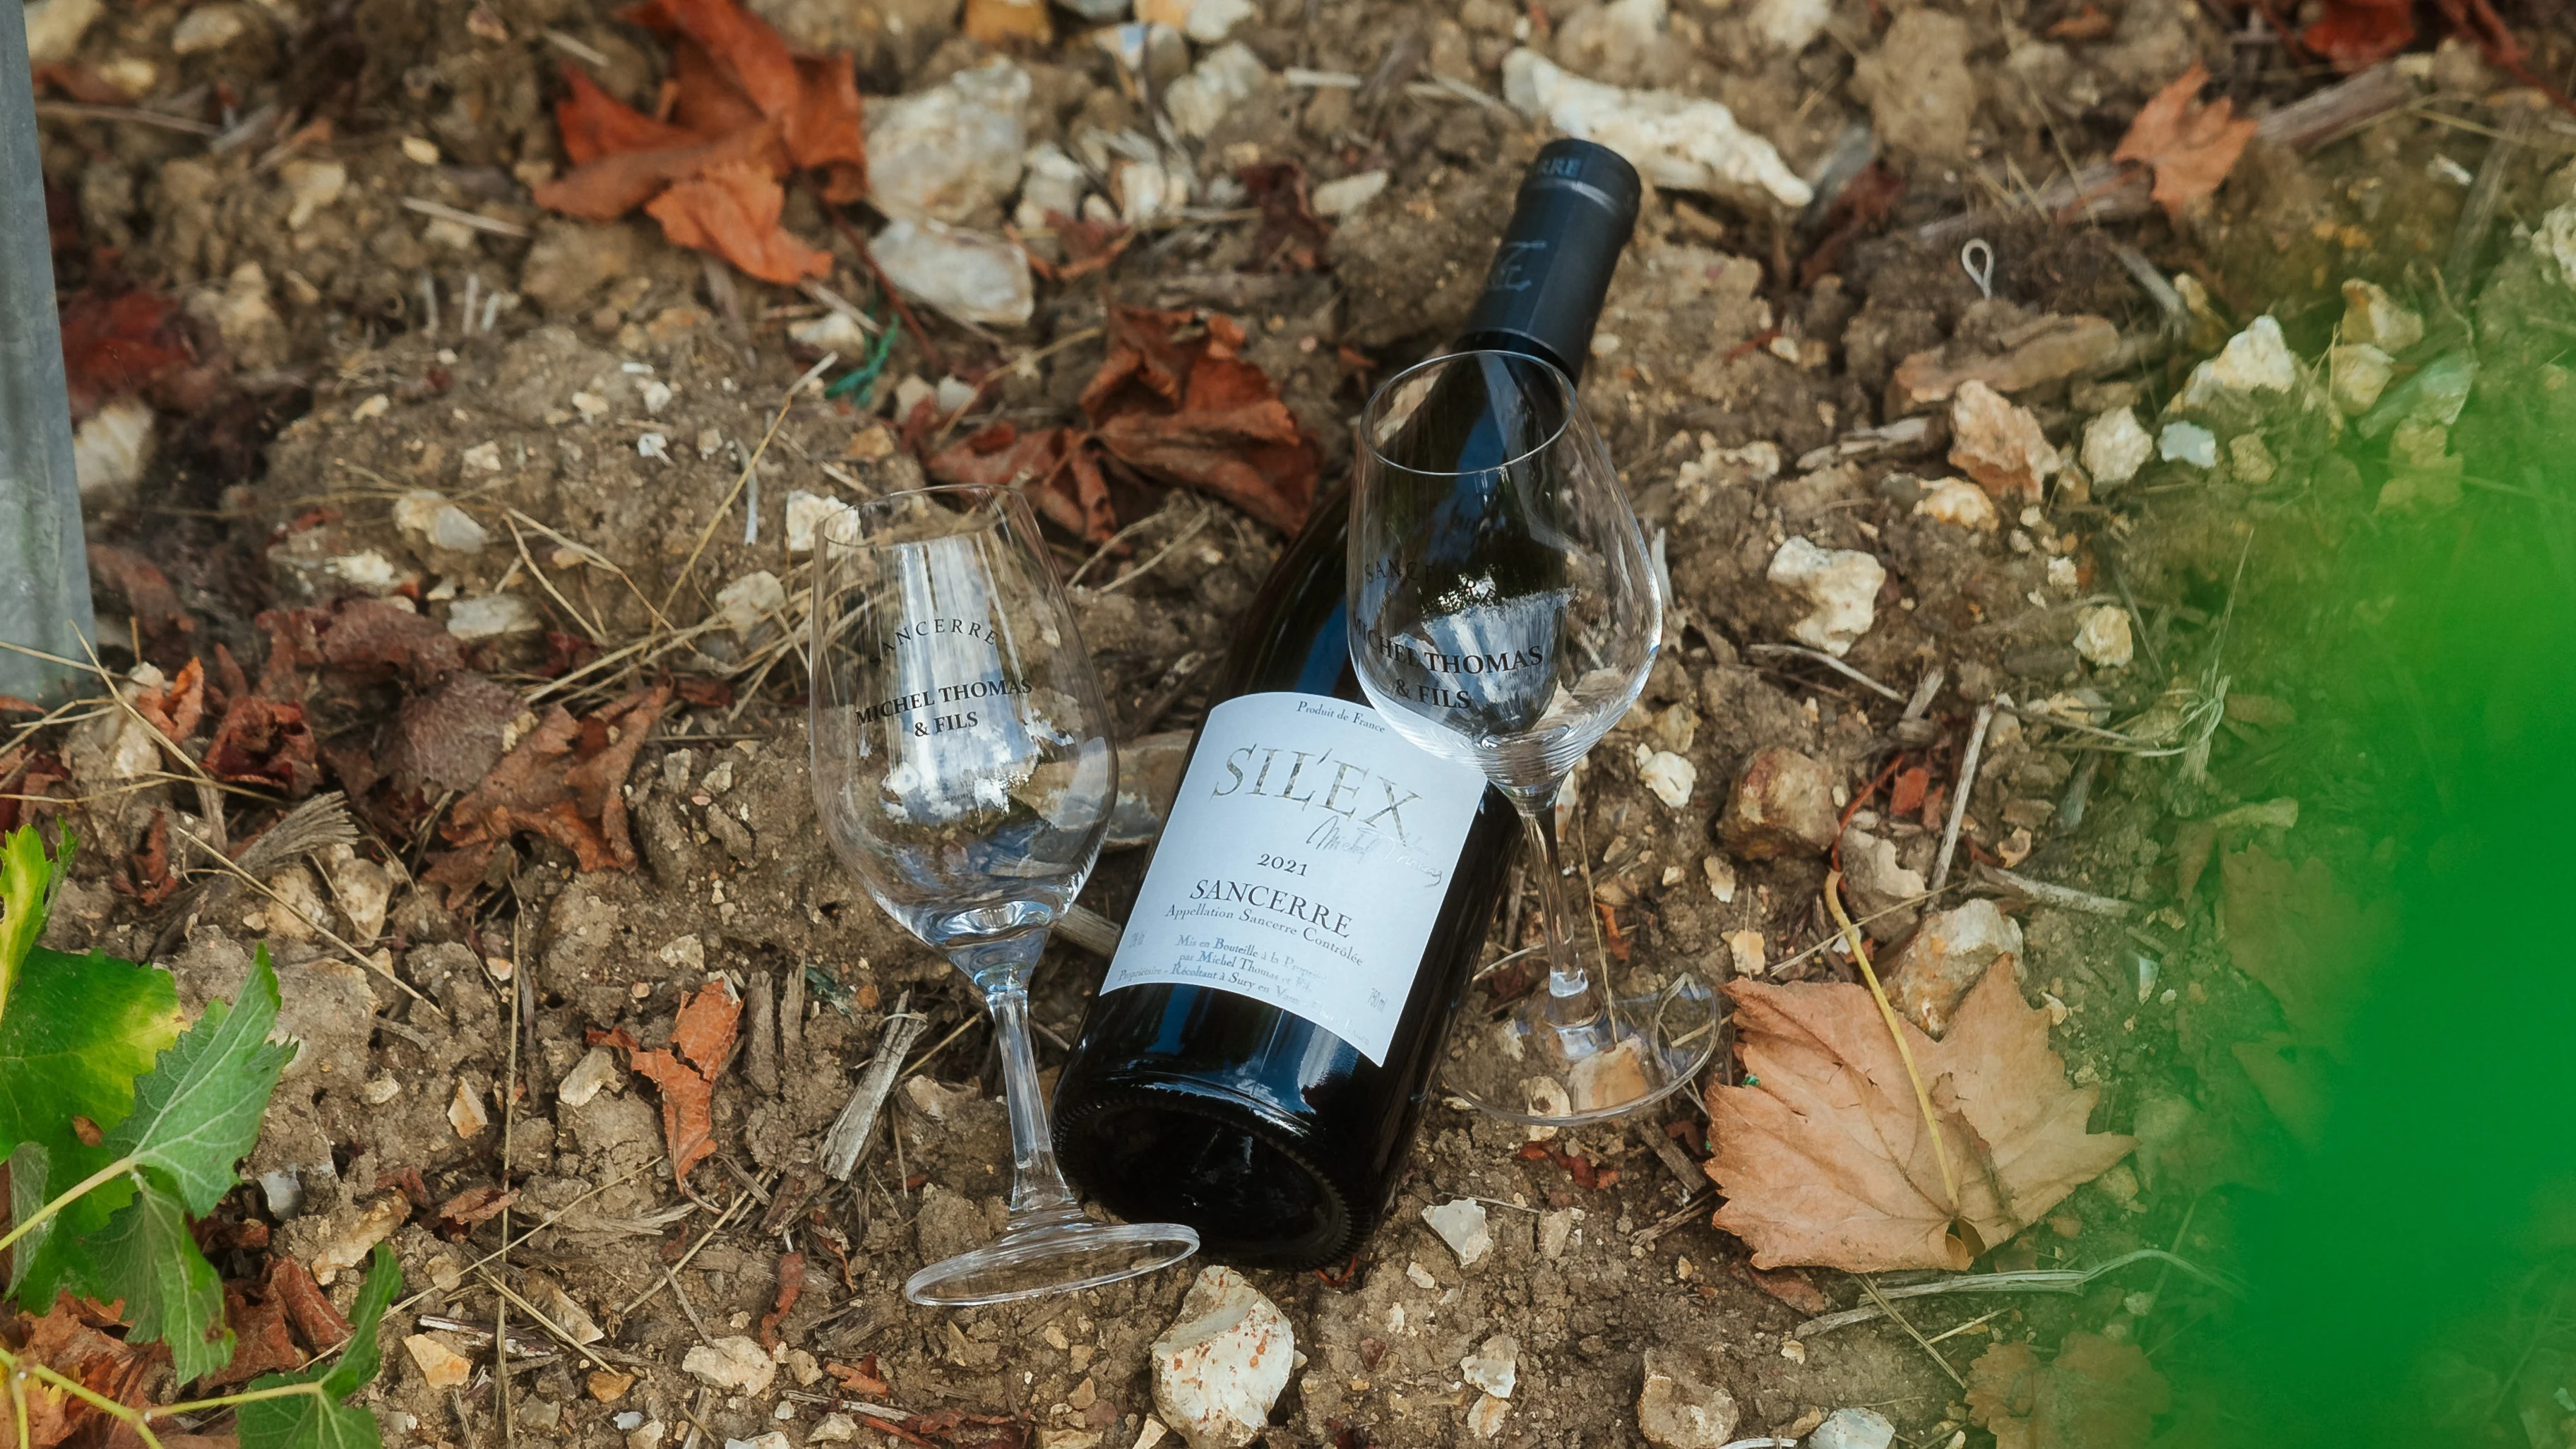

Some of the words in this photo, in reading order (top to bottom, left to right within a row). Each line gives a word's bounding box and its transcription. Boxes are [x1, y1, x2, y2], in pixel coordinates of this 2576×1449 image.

[869, 619, 998, 667] SANCERRE
[1352, 612, 1420, 668] MICHEL
[1424, 645, 1543, 674] THOMAS
[855, 692, 934, 726] MICHEL
[938, 678, 1032, 703] THOMAS
[1395, 679, 1410, 699] &
[1418, 686, 1472, 709] FILS
[914, 722, 929, 737] &
[935, 711, 978, 734] FILS
[1296, 700, 1335, 720] Produit
[1337, 709, 1349, 721] de
[1352, 711, 1385, 733] France
[1257, 853, 1307, 876] 2021
[1190, 880, 1352, 938] SANCERRE
[1165, 903, 1234, 920] Appellation
[1239, 908, 1297, 935] Sancerre
[1304, 927, 1363, 966] Contrôlée
[1175, 934, 1197, 947] Mis
[1212, 937, 1258, 958] Bouteille
[1170, 962, 1217, 979] Récoltant
[1219, 972, 1225, 981] à
[1228, 972, 1256, 993] Sury
[1258, 984, 1269, 994] en
[1177, 954, 1193, 965] par
[1196, 950, 1236, 967] Michel
[1239, 957, 1279, 981] Thomas
